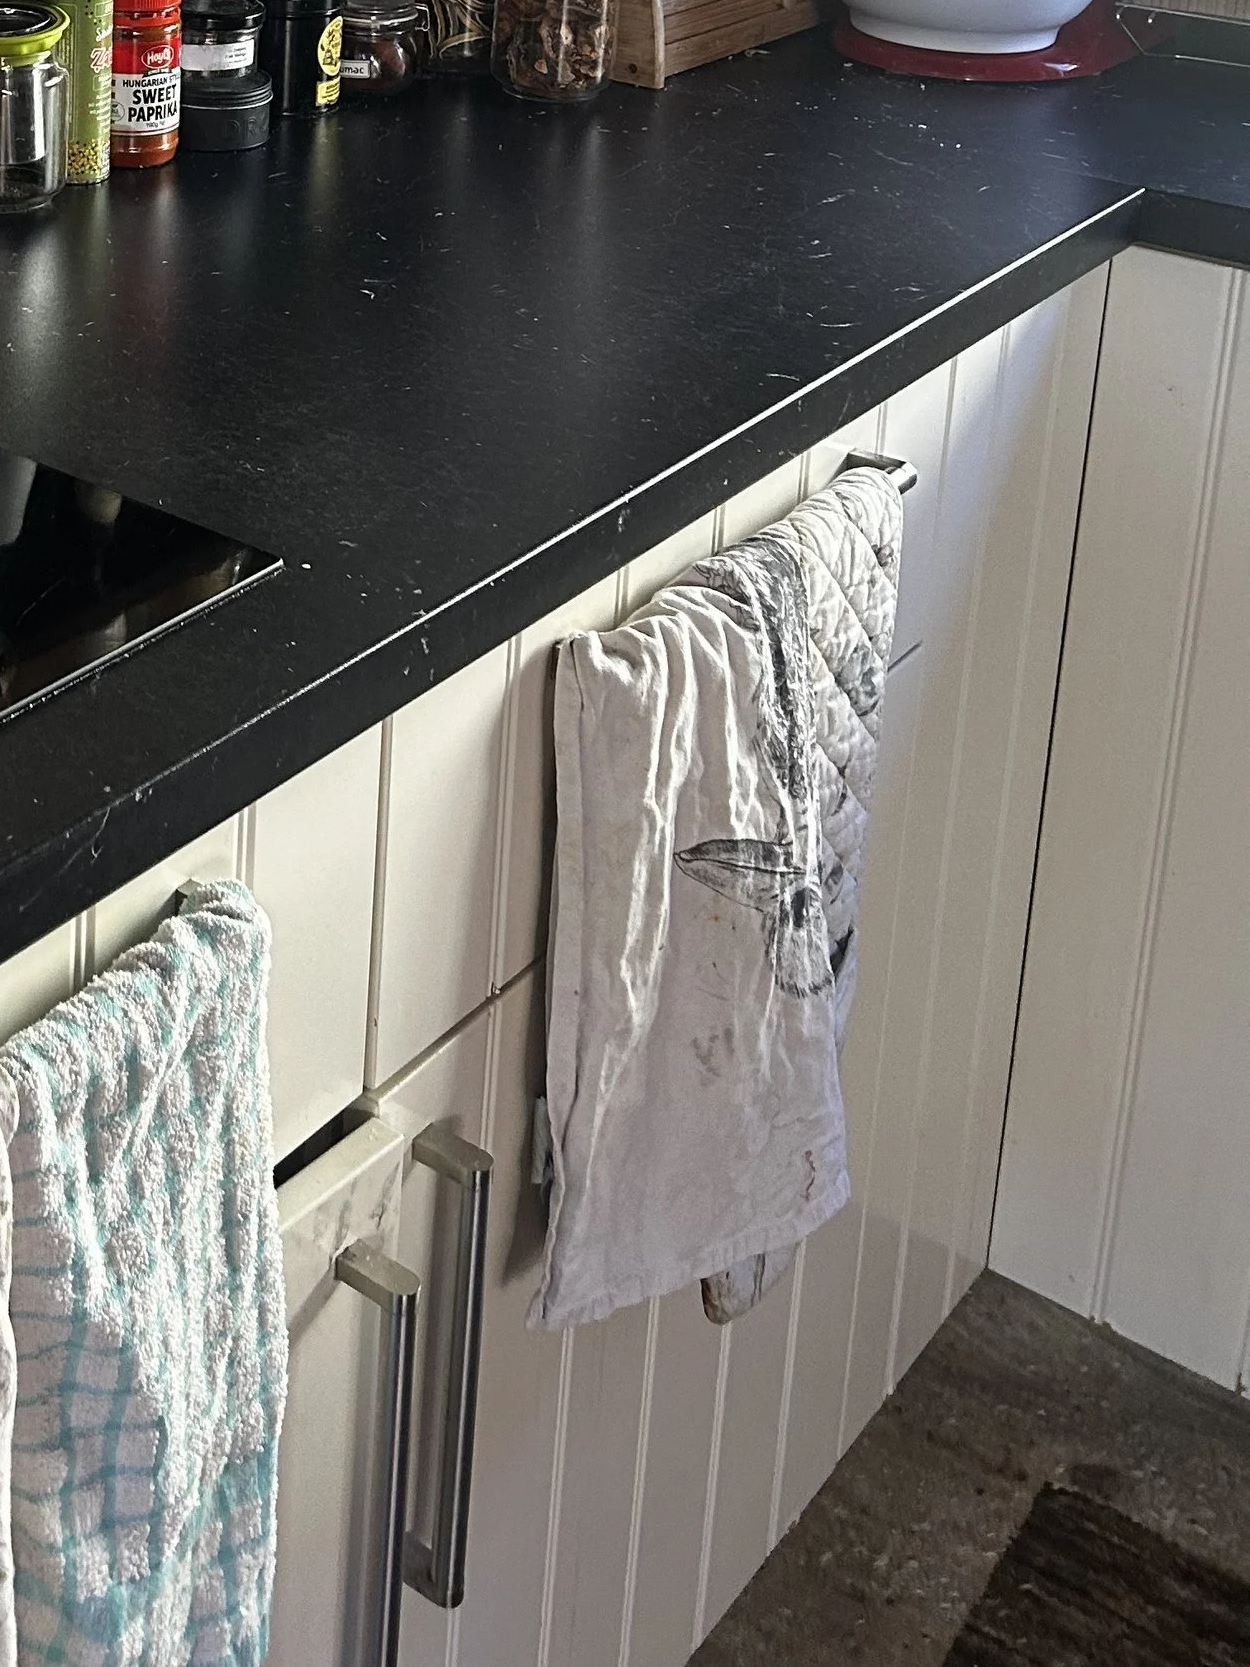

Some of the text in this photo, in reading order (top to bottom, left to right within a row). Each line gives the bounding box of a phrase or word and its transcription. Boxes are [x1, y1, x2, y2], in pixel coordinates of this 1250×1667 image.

[340, 66, 364, 74] umac
[122, 77, 168, 88] HUNGARIAN
[132, 84, 177, 105] SWEET
[128, 101, 178, 122] PAPRIKA
